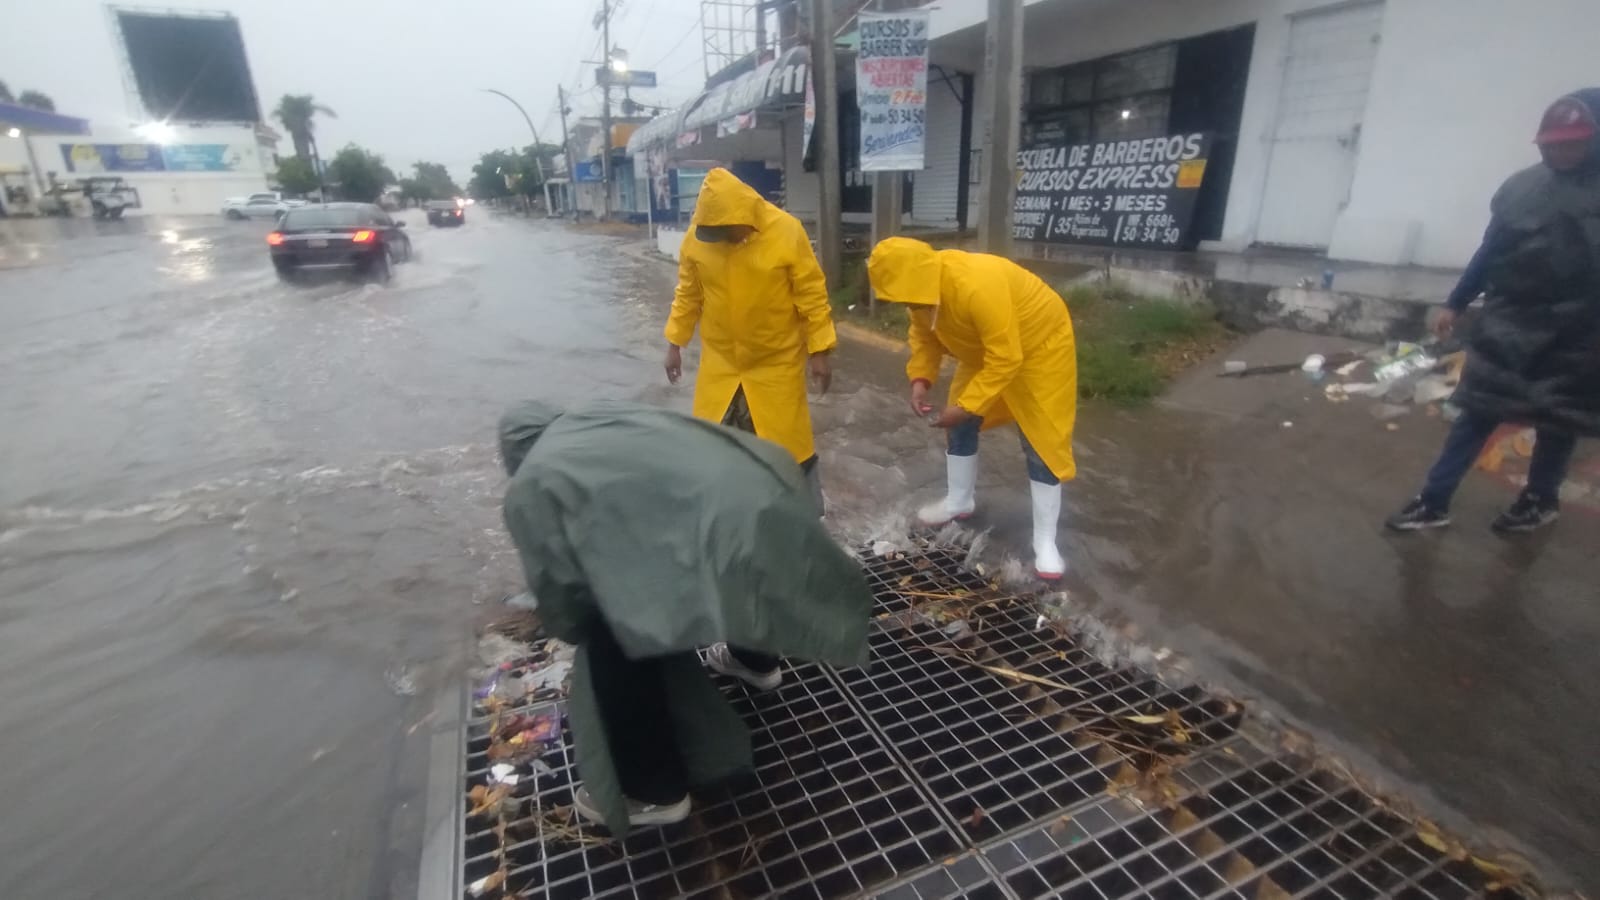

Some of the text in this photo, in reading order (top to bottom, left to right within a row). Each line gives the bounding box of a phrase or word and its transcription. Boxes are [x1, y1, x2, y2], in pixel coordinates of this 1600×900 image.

[860, 18, 910, 38] CURSOS
[860, 39, 902, 58] BARBER
[1016, 132, 1203, 169] ESCUELA DE BARBEROS
[1017, 169, 1075, 191] CURSOS
[1078, 164, 1180, 190] EXPRESS
[1014, 196, 1051, 211] SEMANA
[1068, 195, 1094, 211] MES
[1101, 195, 1111, 211] 3
[1114, 195, 1168, 211] MESES
[1054, 216, 1073, 234] 35
